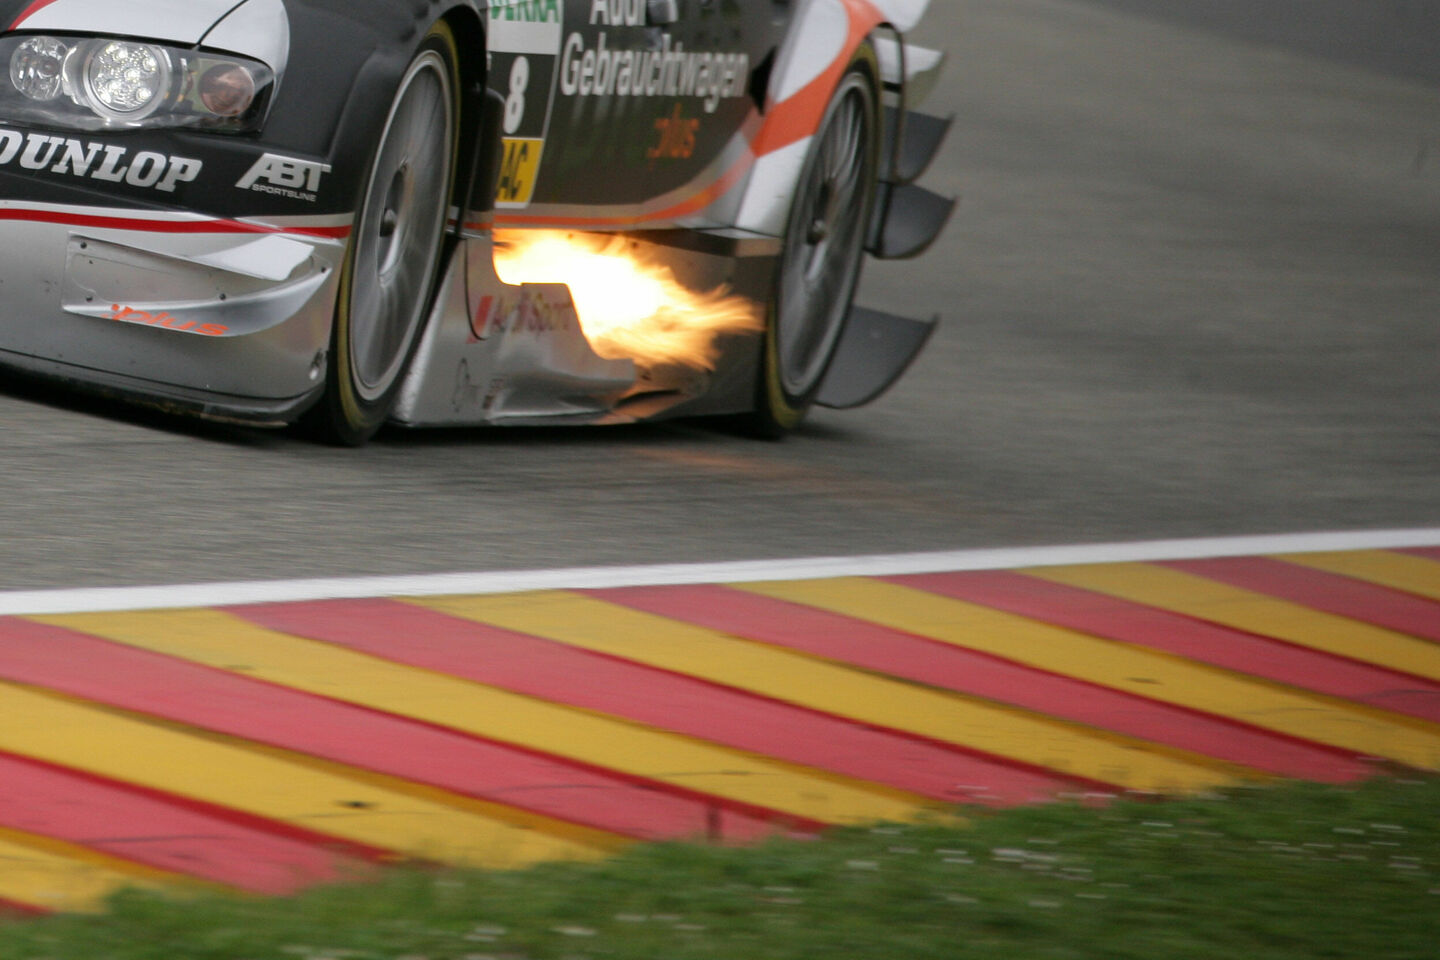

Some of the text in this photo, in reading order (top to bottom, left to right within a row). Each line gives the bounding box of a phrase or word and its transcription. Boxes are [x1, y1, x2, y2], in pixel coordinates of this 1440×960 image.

[502, 55, 530, 134] 8
[561, 31, 749, 114] Gebrauchtwagen
[235, 152, 332, 192] ABT
[251, 183, 318, 203] SPORTSLINE
